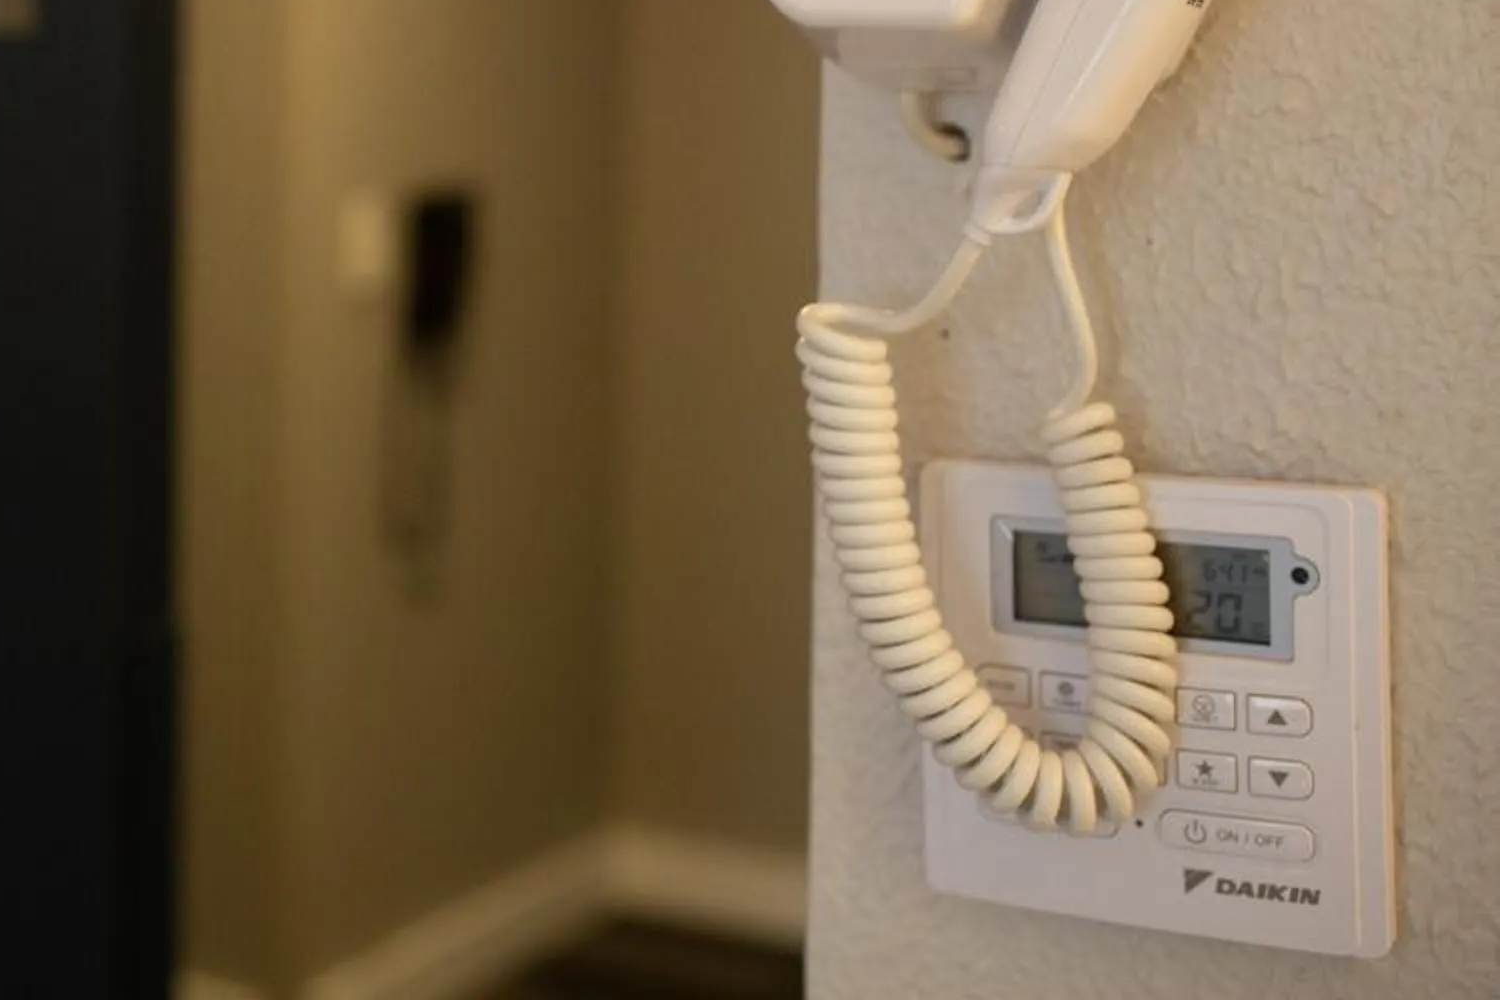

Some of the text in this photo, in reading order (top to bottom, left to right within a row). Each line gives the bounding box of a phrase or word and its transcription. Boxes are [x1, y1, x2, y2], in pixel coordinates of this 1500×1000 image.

[1185, 590, 1243, 635] 20
[1215, 828, 1239, 844] ON
[1254, 833, 1284, 848] OFF
[1215, 877, 1322, 906] DAIKIN
